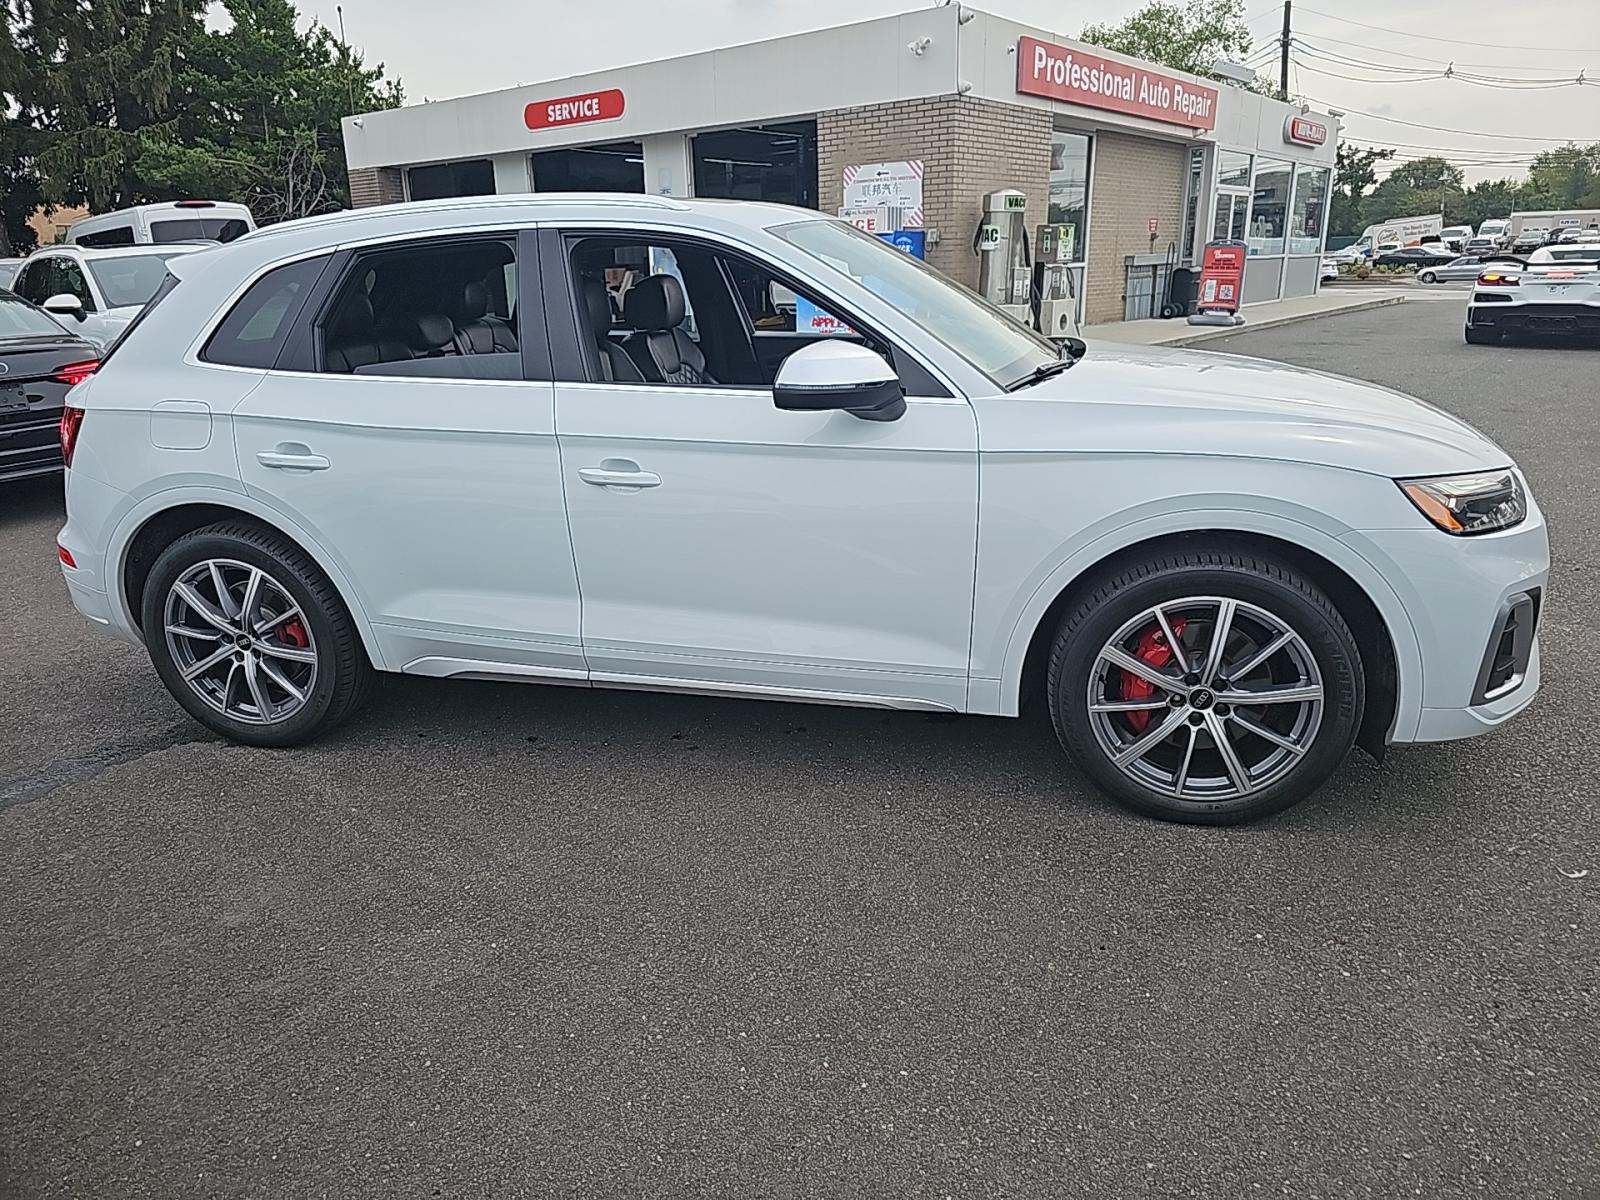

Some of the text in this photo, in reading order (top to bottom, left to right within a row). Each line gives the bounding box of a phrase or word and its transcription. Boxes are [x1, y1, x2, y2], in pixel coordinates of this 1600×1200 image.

[1033, 45, 1211, 121] Professional Auto Repair
[547, 98, 600, 122] SERVICE
